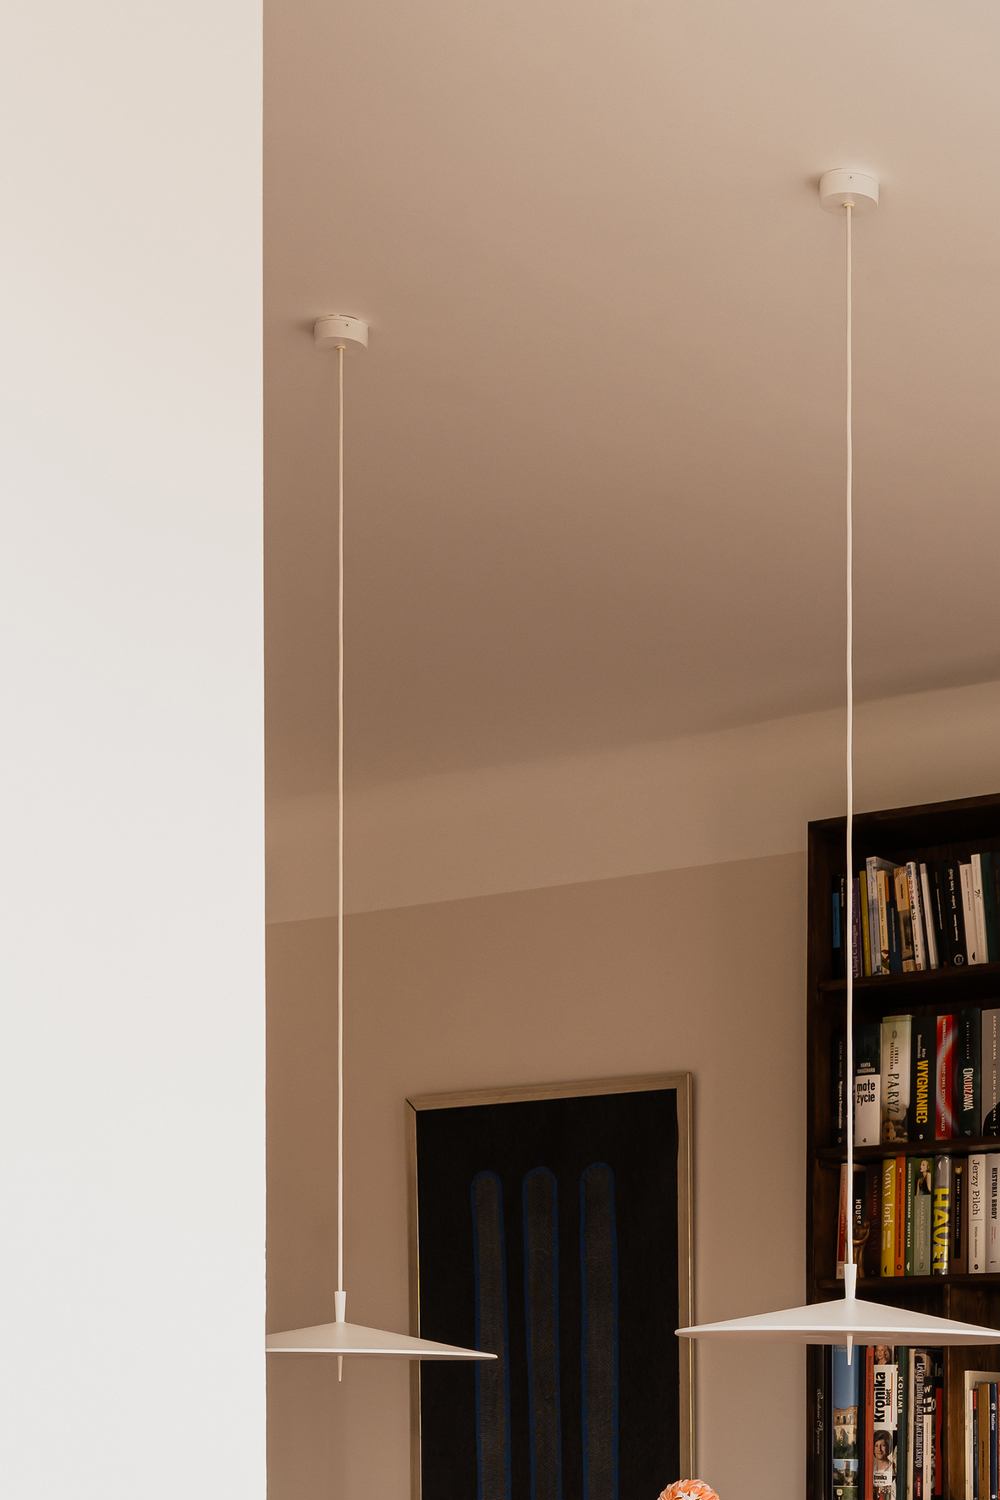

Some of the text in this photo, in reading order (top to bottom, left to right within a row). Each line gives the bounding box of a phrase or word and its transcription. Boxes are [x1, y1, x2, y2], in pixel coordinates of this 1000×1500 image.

[857, 1079, 875, 1092] małe
[857, 1091, 875, 1106] życie
[916, 1060, 928, 1123] WYGNANIEC
[962, 1068, 974, 1111] OKUDŻAWA
[971, 1160, 980, 1187] Jerzy
[932, 1188, 950, 1275] HAVEL
[874, 1372, 886, 1422] Kronika
